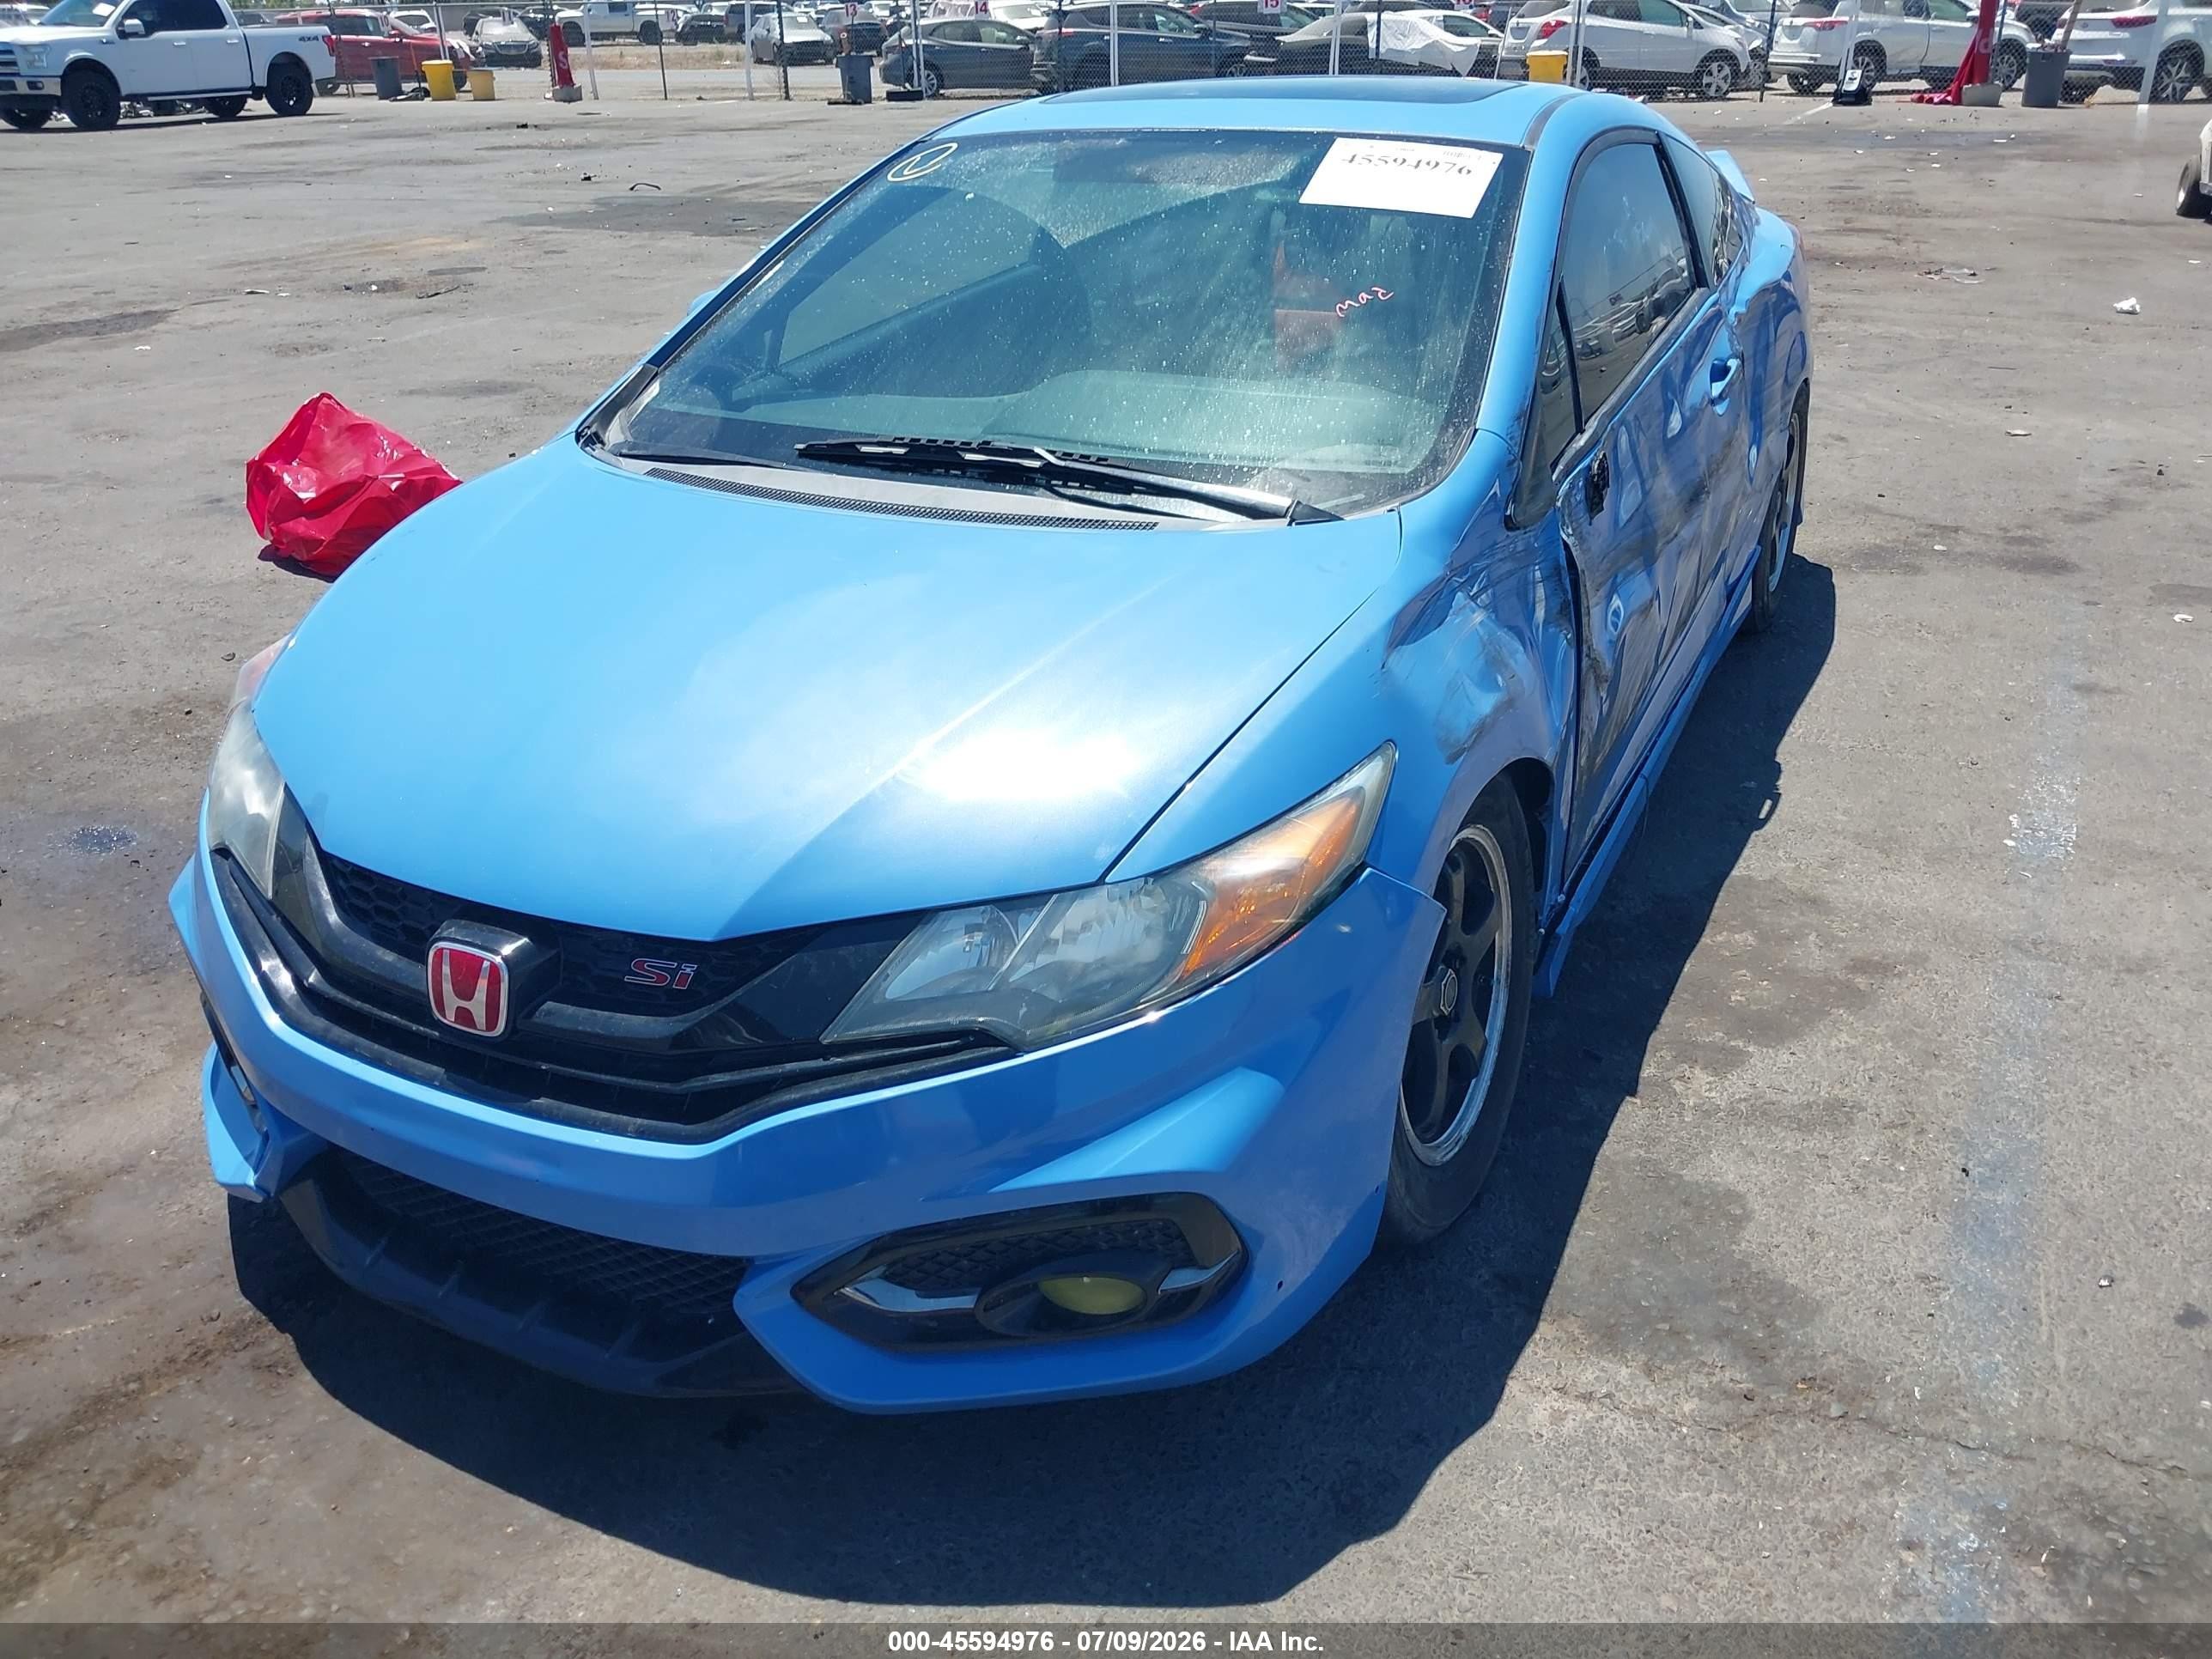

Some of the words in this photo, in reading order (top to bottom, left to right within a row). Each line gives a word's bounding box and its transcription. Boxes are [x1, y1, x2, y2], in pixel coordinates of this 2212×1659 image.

[845, 4, 857, 17] 13
[975, 2, 988, 15] 14
[1340, 153, 1474, 175] 45594976
[624, 958, 698, 989] Si
